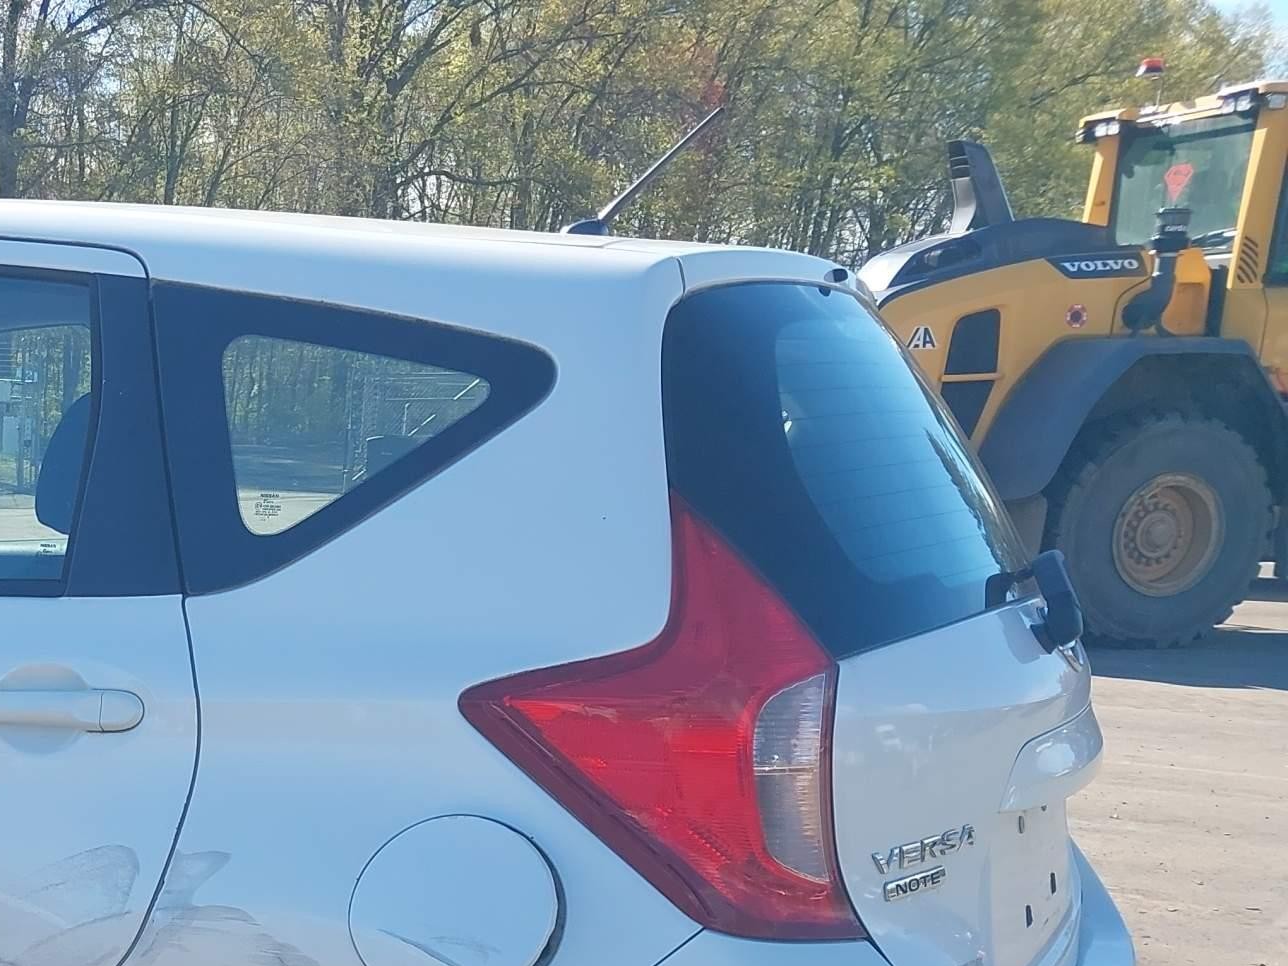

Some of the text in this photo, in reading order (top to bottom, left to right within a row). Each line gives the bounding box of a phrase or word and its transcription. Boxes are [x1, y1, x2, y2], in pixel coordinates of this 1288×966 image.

[1060, 258, 1139, 272] VOLVO
[872, 823, 975, 875] VERSA
[895, 871, 941, 897] NOTE
